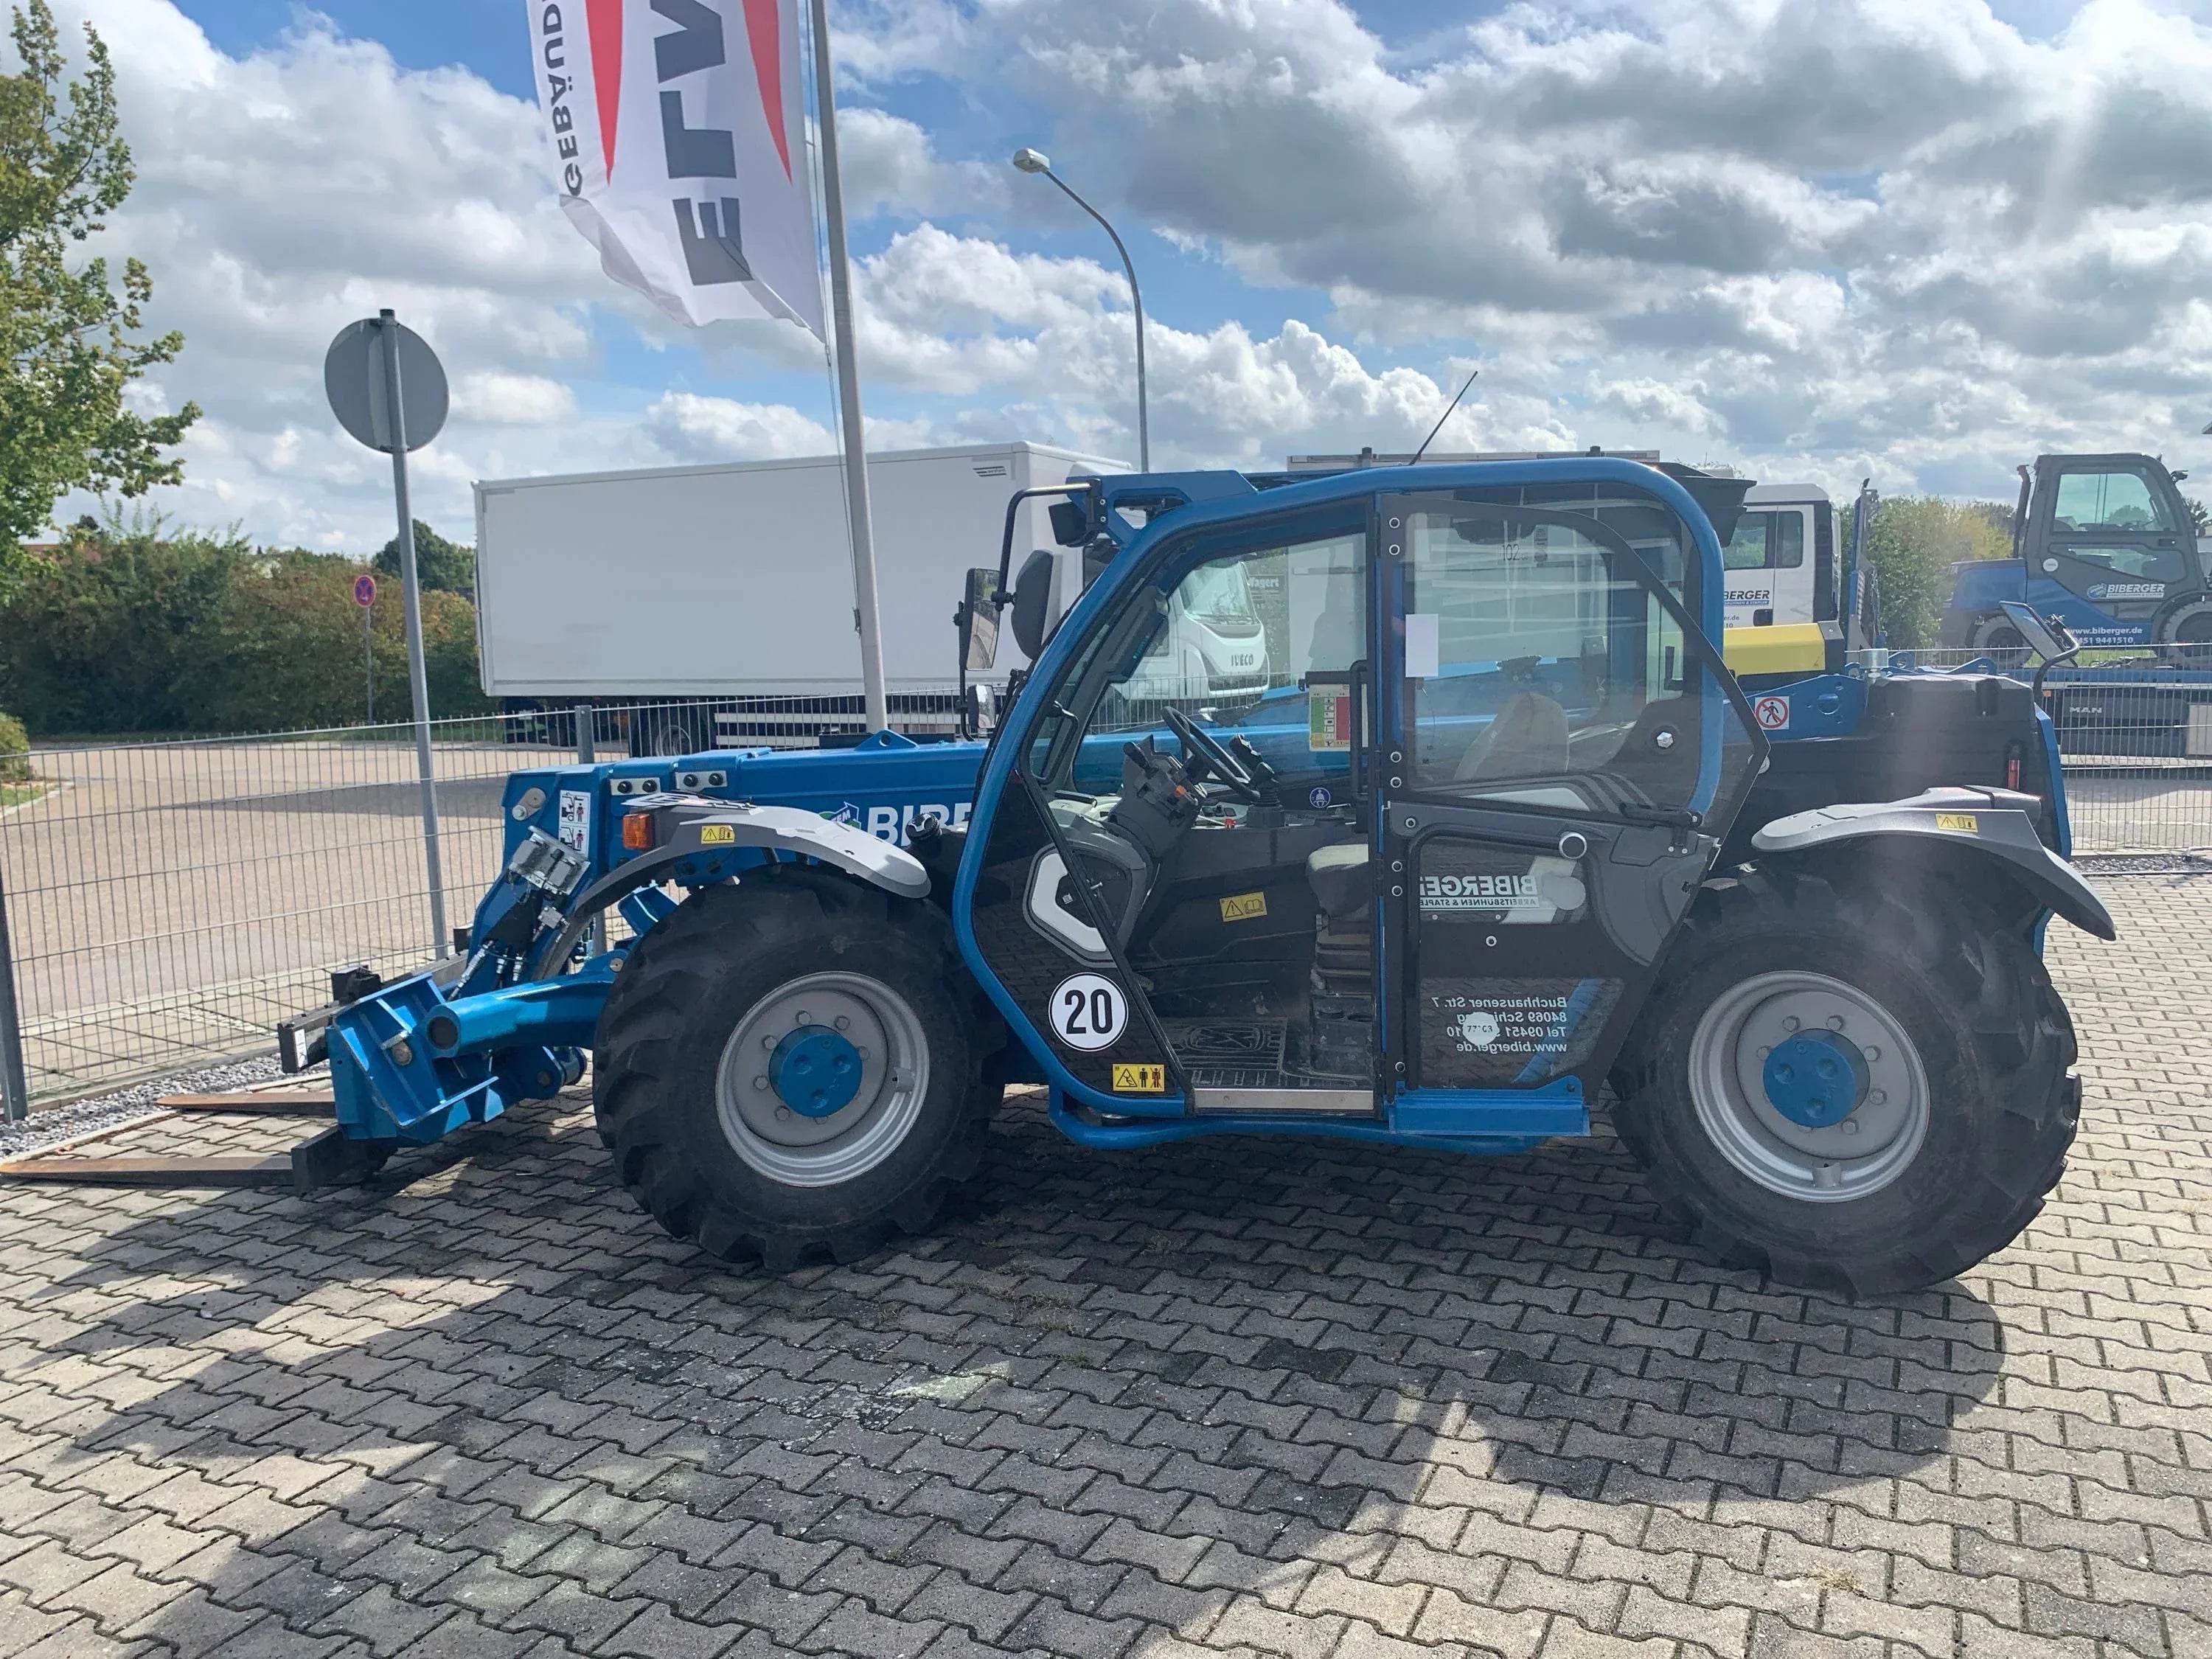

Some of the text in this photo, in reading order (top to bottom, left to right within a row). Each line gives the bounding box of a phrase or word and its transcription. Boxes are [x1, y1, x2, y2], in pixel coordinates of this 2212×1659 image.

[1502, 543, 1520, 560] 102
[2107, 583, 2166, 593] BIBERGER
[1231, 653, 1253, 667] IVECO
[1064, 988, 1113, 1034] 20
